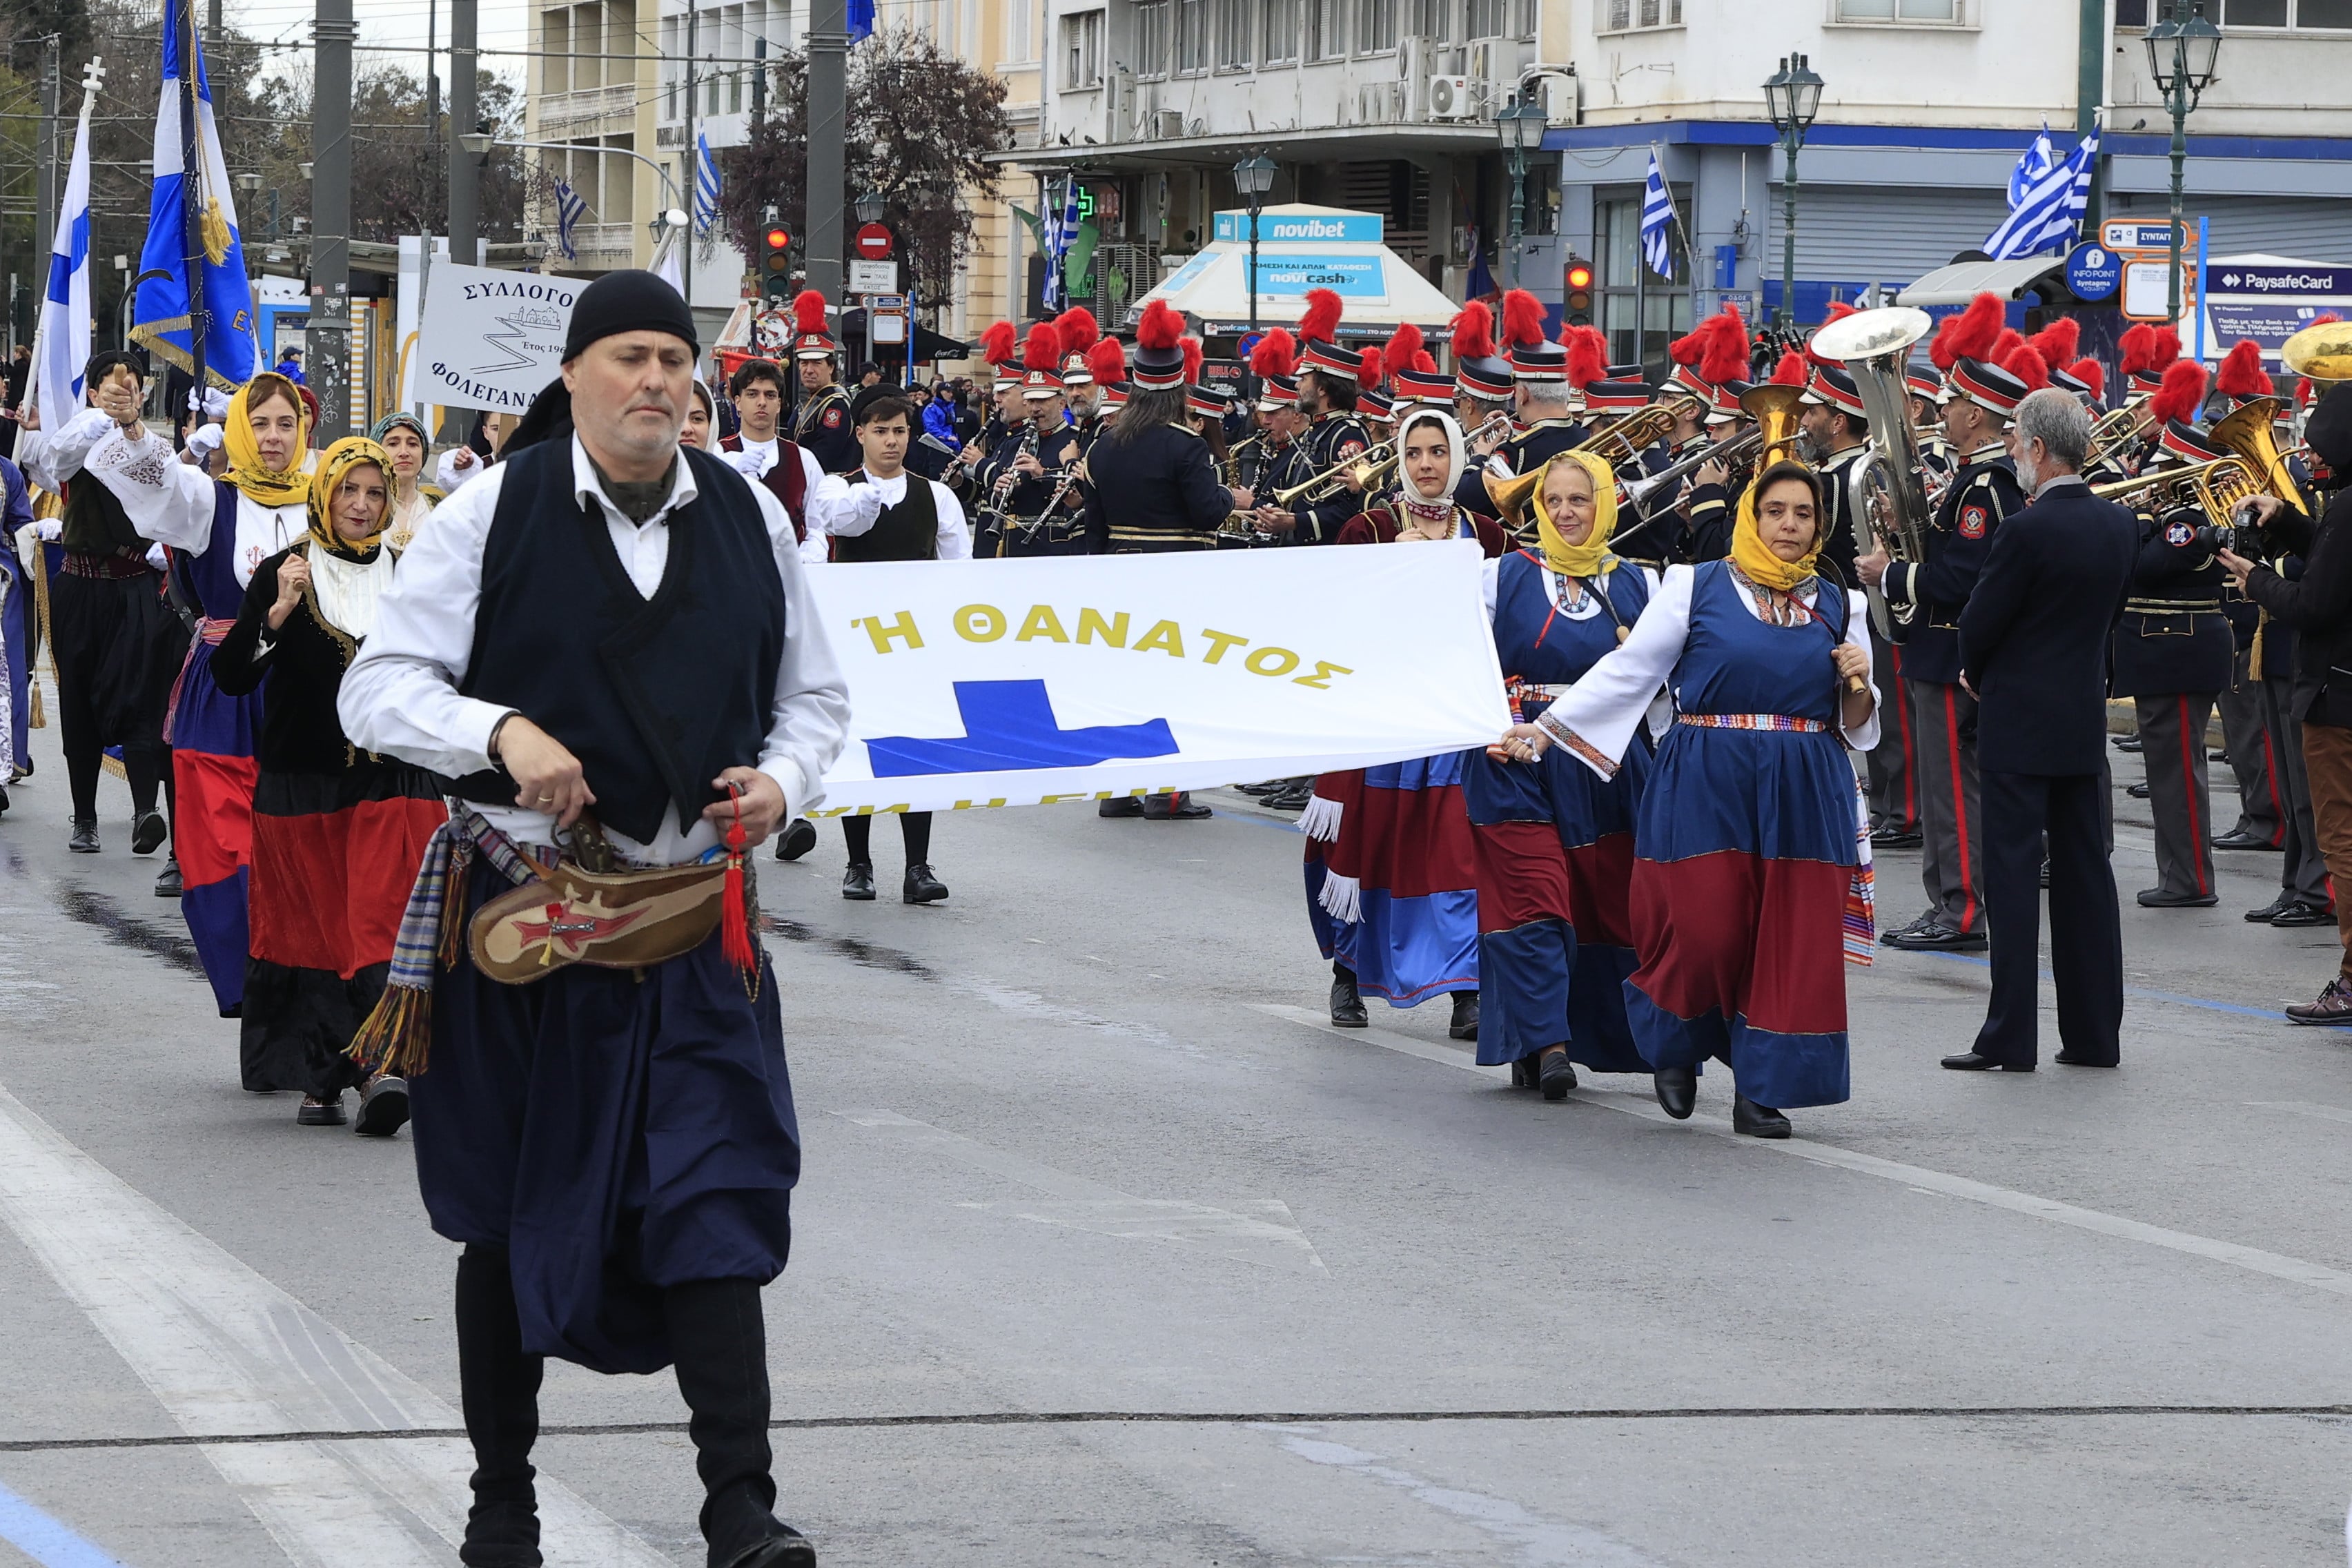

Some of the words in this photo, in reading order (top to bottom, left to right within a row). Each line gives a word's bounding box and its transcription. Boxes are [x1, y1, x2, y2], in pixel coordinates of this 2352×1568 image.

[1273, 220, 1345, 237] novibet
[2141, 233, 2172, 241] ΣΥΝΤΑΓ
[1270, 271, 1345, 284] novicash
[2246, 274, 2333, 291] PaysafeCard
[463, 282, 574, 307] ΣΥΛΛΟΓΟ
[522, 341, 545, 353] Έτος
[549, 345, 566, 354] 196
[431, 362, 538, 407] ΦΟΛΕΓΑΝΔ
[850, 610, 925, 654] Ή
[953, 604, 1354, 689] ΘΑΝΑΤΟΣ
